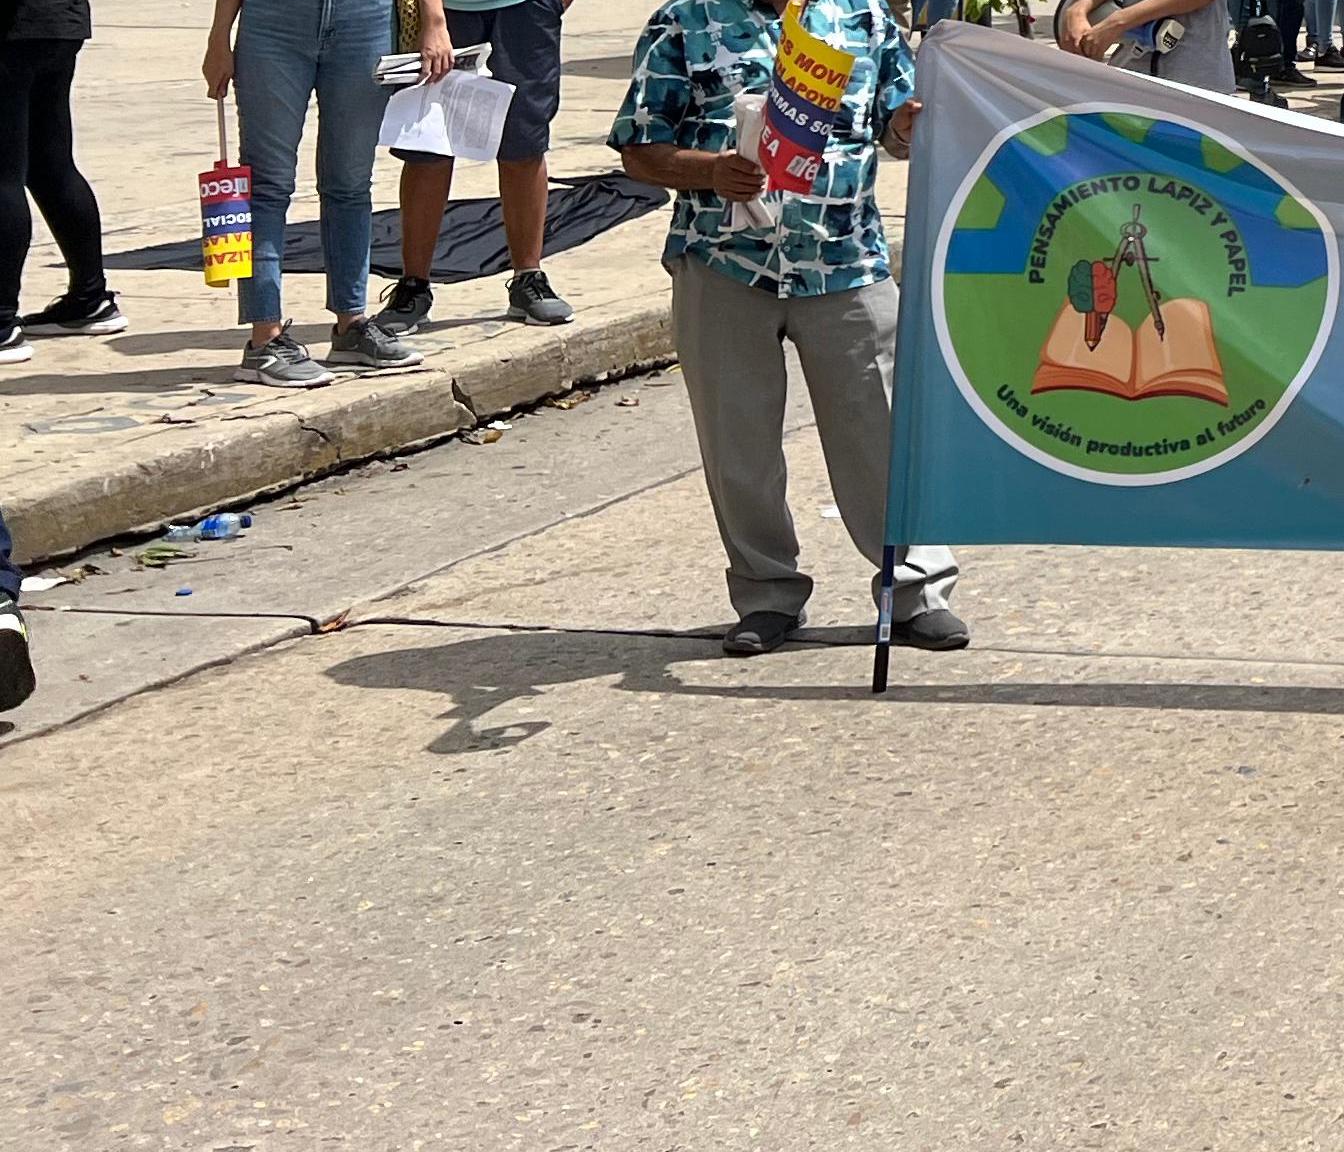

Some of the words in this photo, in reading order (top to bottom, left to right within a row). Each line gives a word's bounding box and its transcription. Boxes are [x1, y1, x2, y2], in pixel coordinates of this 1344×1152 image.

[784, 75, 837, 110] APOYO
[1146, 176, 1213, 216] LAPIZ
[1209, 207, 1229, 228] Y
[1028, 174, 1141, 284] PENSAMIENTO
[1218, 228, 1248, 298] PAPEL
[996, 383, 1028, 421] Una
[1031, 412, 1083, 448] visión
[1086, 436, 1192, 459] productiva
[1195, 424, 1216, 448] al
[1216, 396, 1267, 436] futuro
